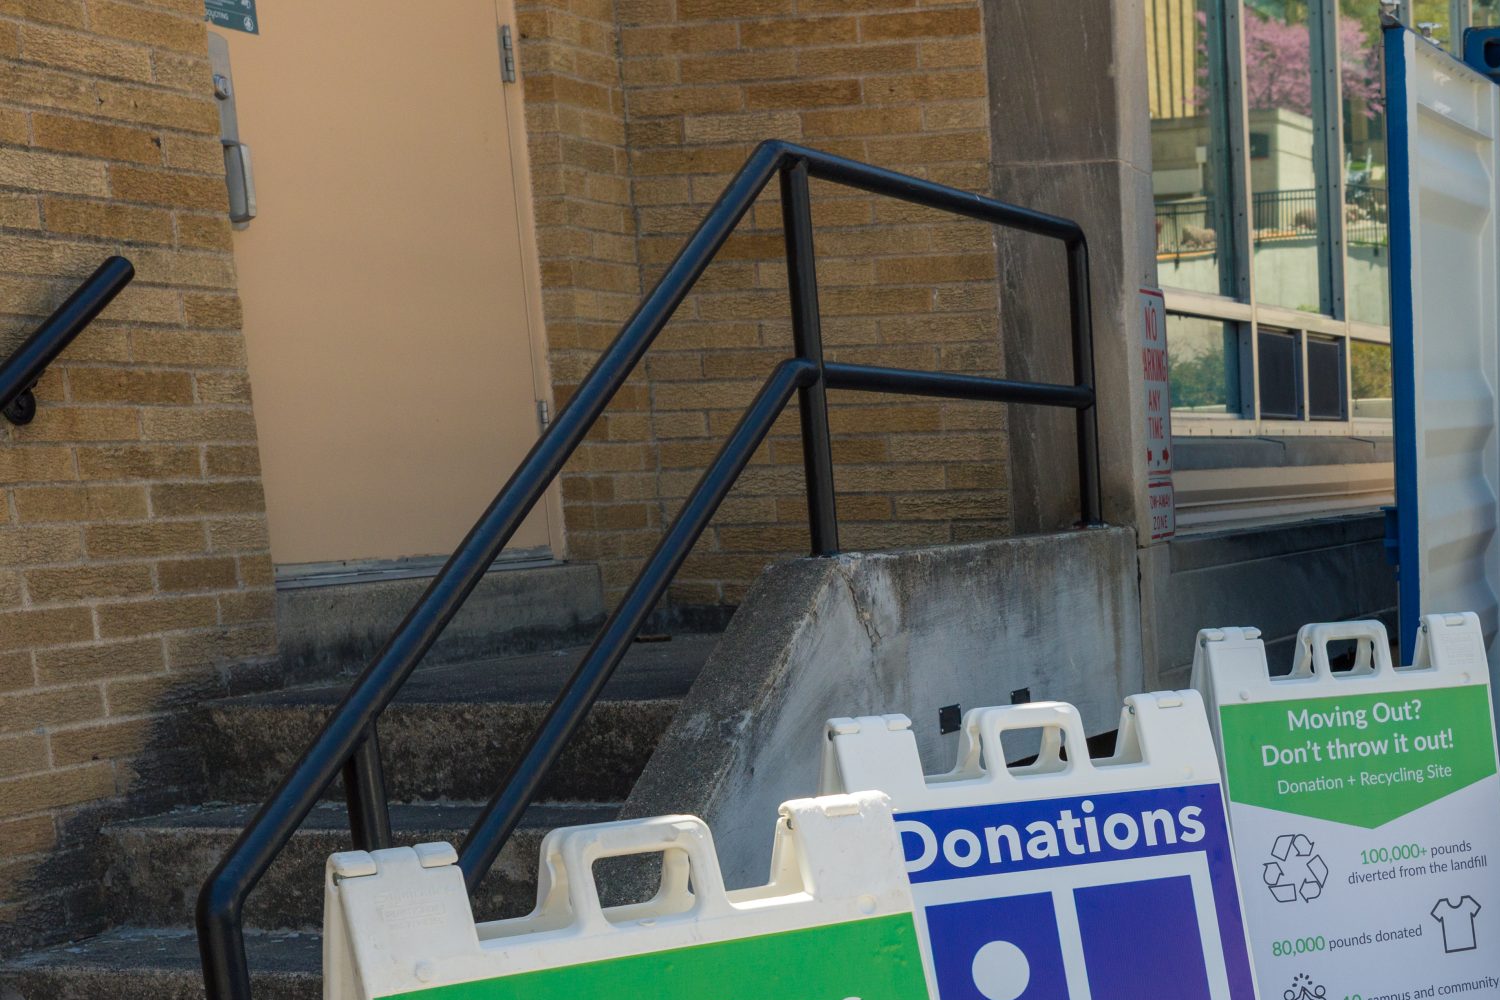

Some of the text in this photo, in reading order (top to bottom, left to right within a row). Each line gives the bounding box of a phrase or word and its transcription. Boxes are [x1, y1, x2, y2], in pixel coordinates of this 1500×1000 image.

[1144, 307, 1158, 341] NO
[1148, 416, 1164, 440] TIME
[1287, 699, 1422, 732] Moving Out?
[1261, 728, 1454, 767] Don't throw it out!
[1277, 774, 1344, 795] Donation
[1360, 767, 1424, 787] Recycling
[1427, 764, 1452, 779] Site
[901, 800, 1206, 872] Donations
[1360, 840, 1472, 865] 100,000+ pounds
[1348, 855, 1488, 885] diverted from the landfill
[1272, 925, 1423, 957] 80,000 pounds donated
[1413, 985, 1436, 1000] and
[1437, 976, 1500, 997] community
